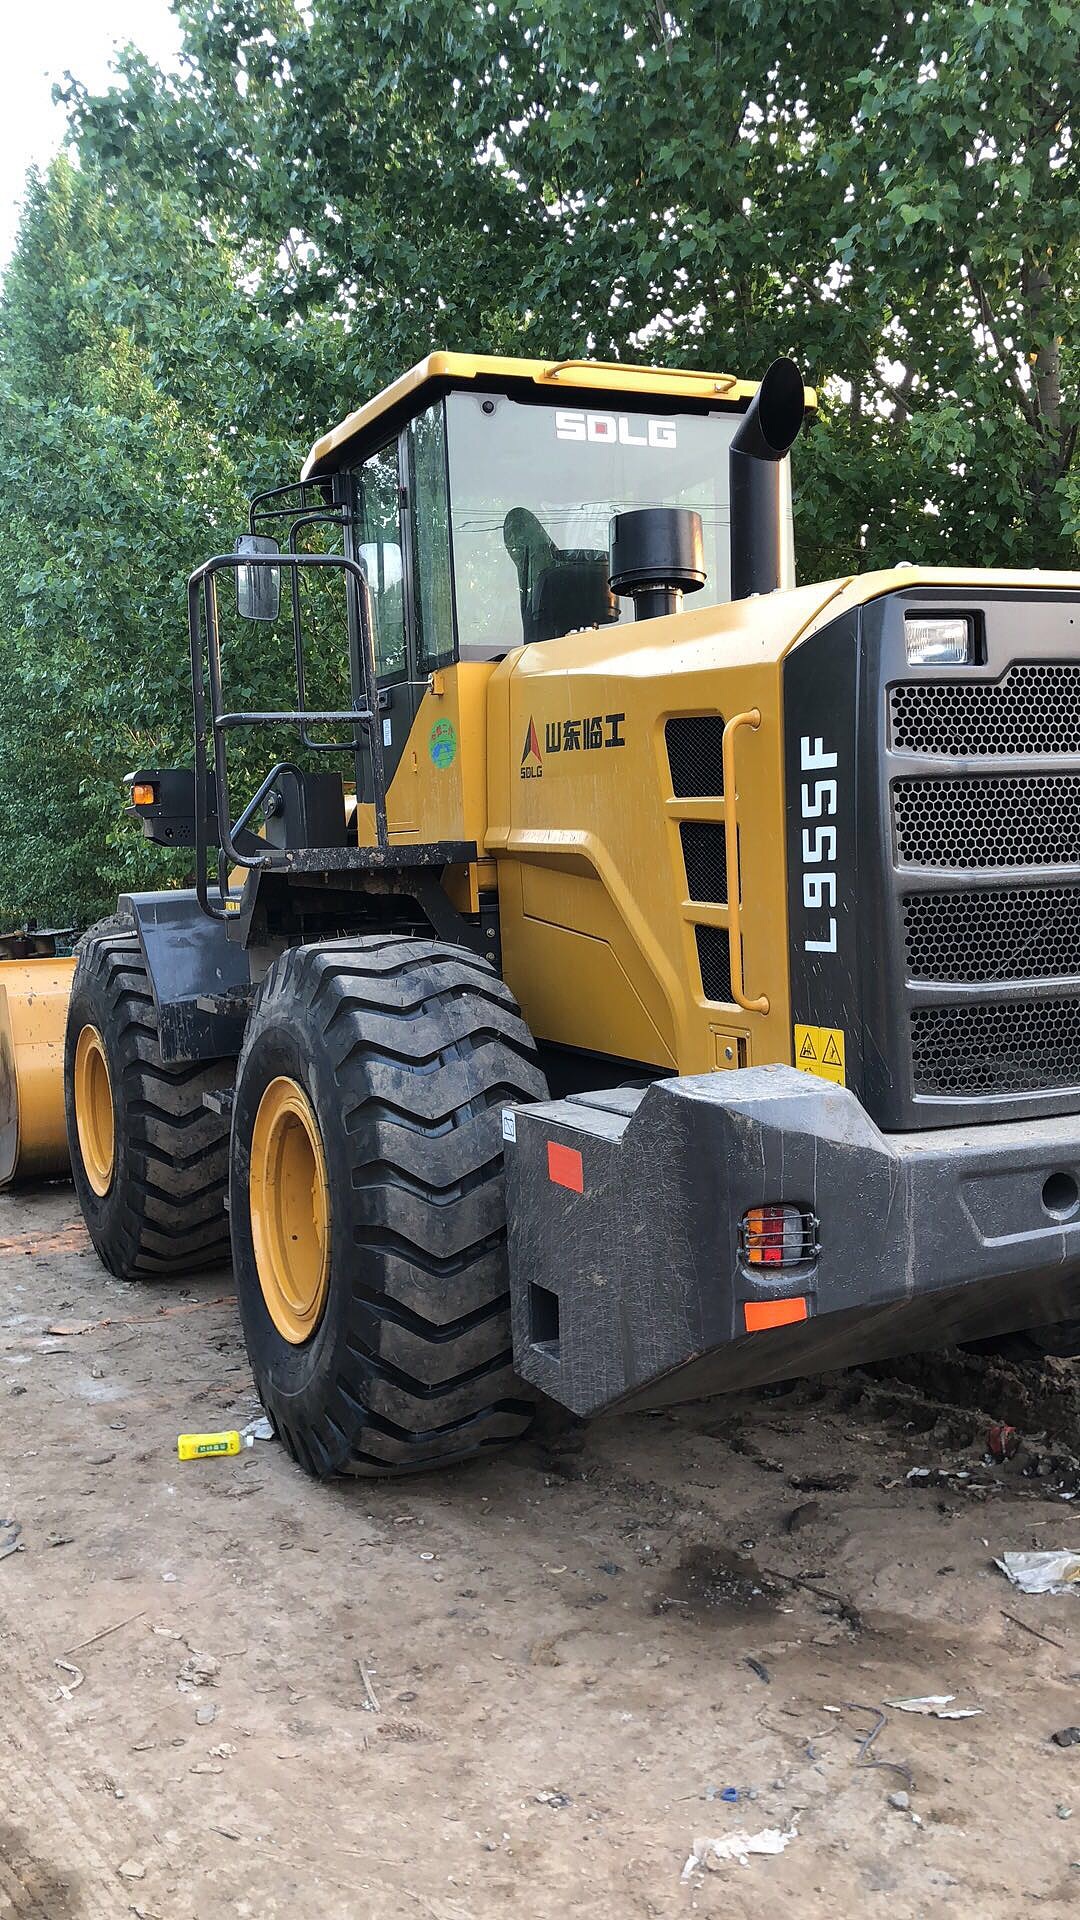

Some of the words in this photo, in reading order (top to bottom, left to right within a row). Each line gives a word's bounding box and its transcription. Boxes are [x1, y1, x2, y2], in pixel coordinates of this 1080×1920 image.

[555, 411, 677, 448] SDLG
[545, 713, 625, 753] 山东临工
[521, 766, 542, 779] SDLG
[800, 736, 838, 952] L955F
